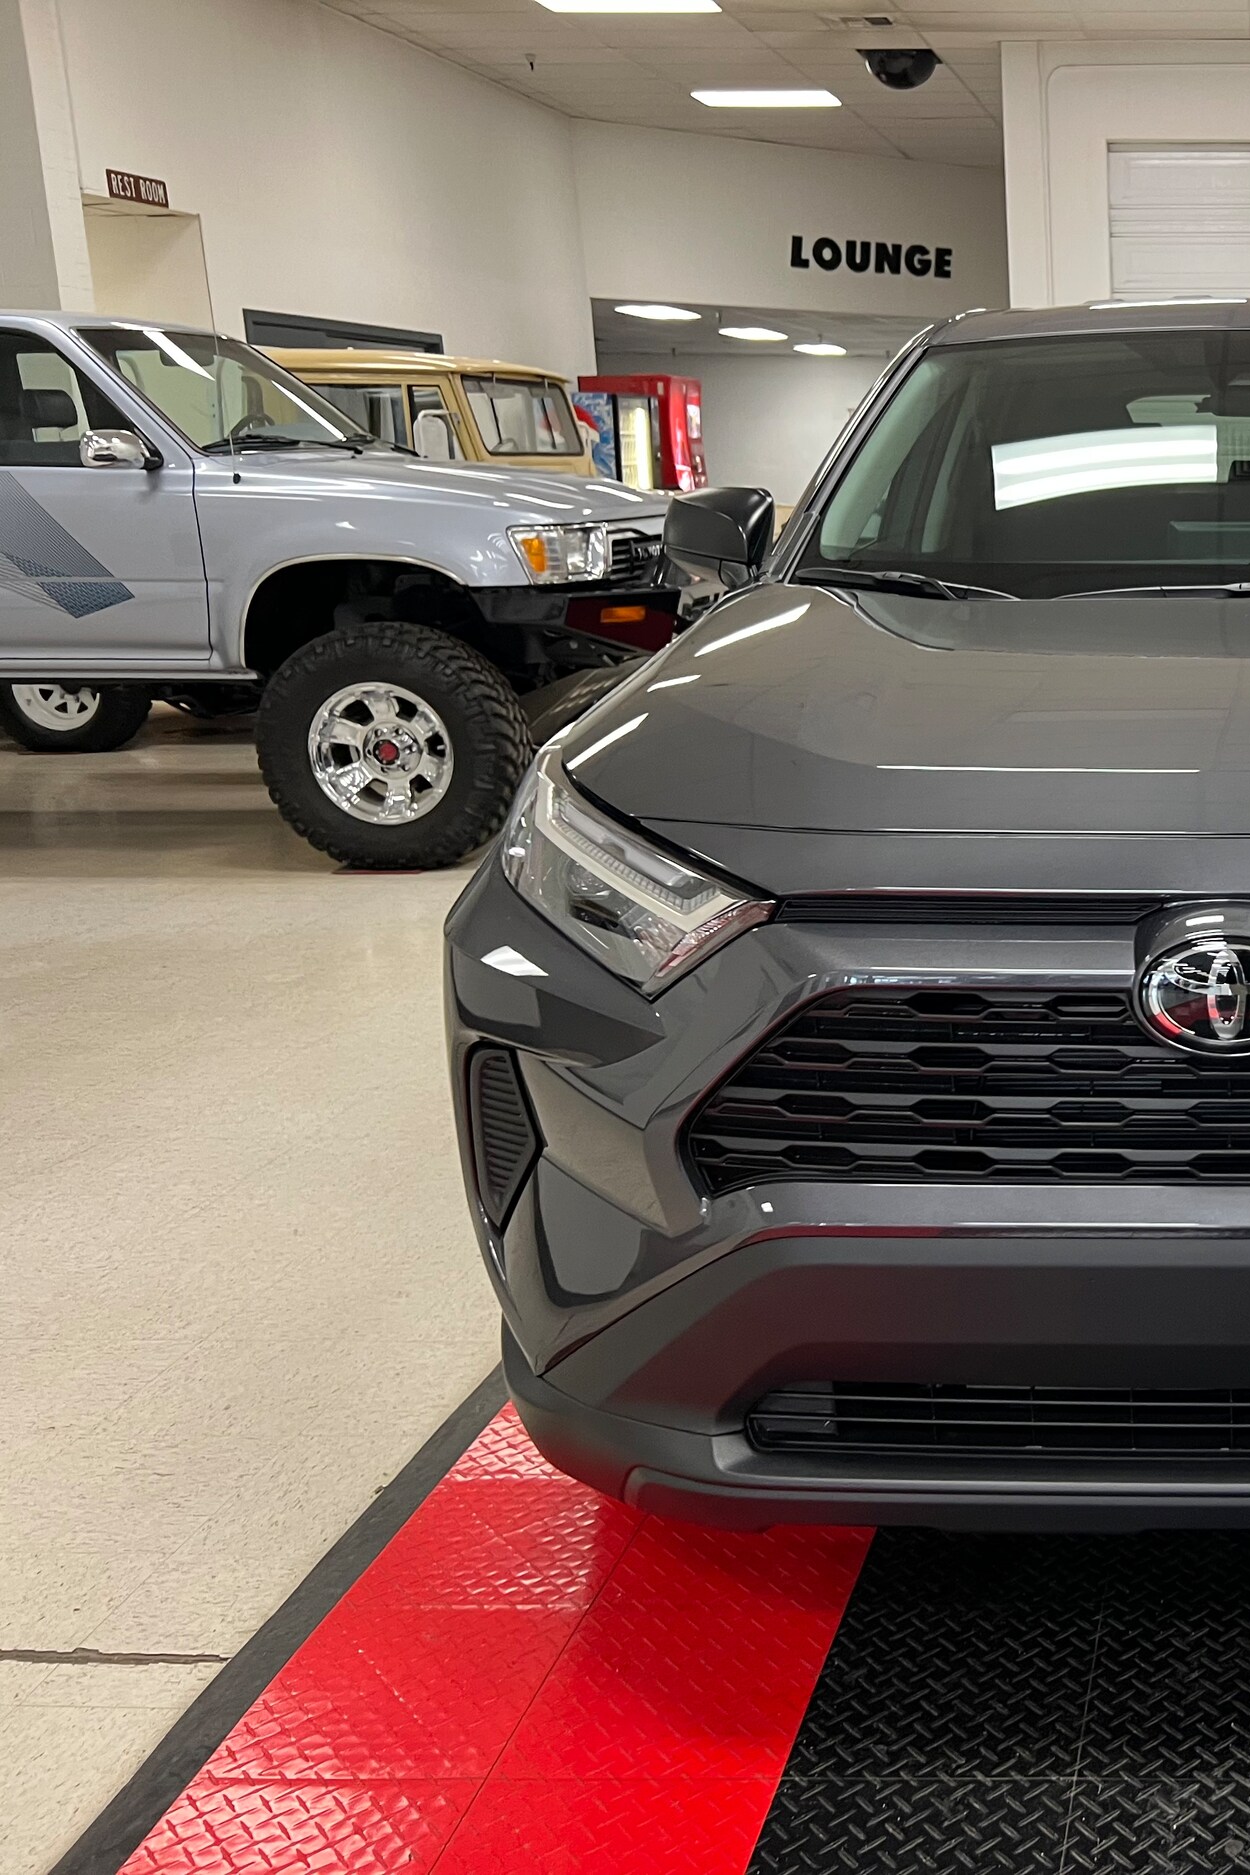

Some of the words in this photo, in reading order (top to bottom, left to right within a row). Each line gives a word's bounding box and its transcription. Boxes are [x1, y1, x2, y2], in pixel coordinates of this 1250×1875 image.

[110, 173, 136, 198] REST
[140, 178, 166, 204] ROOM
[790, 235, 952, 278] LOUNGE
